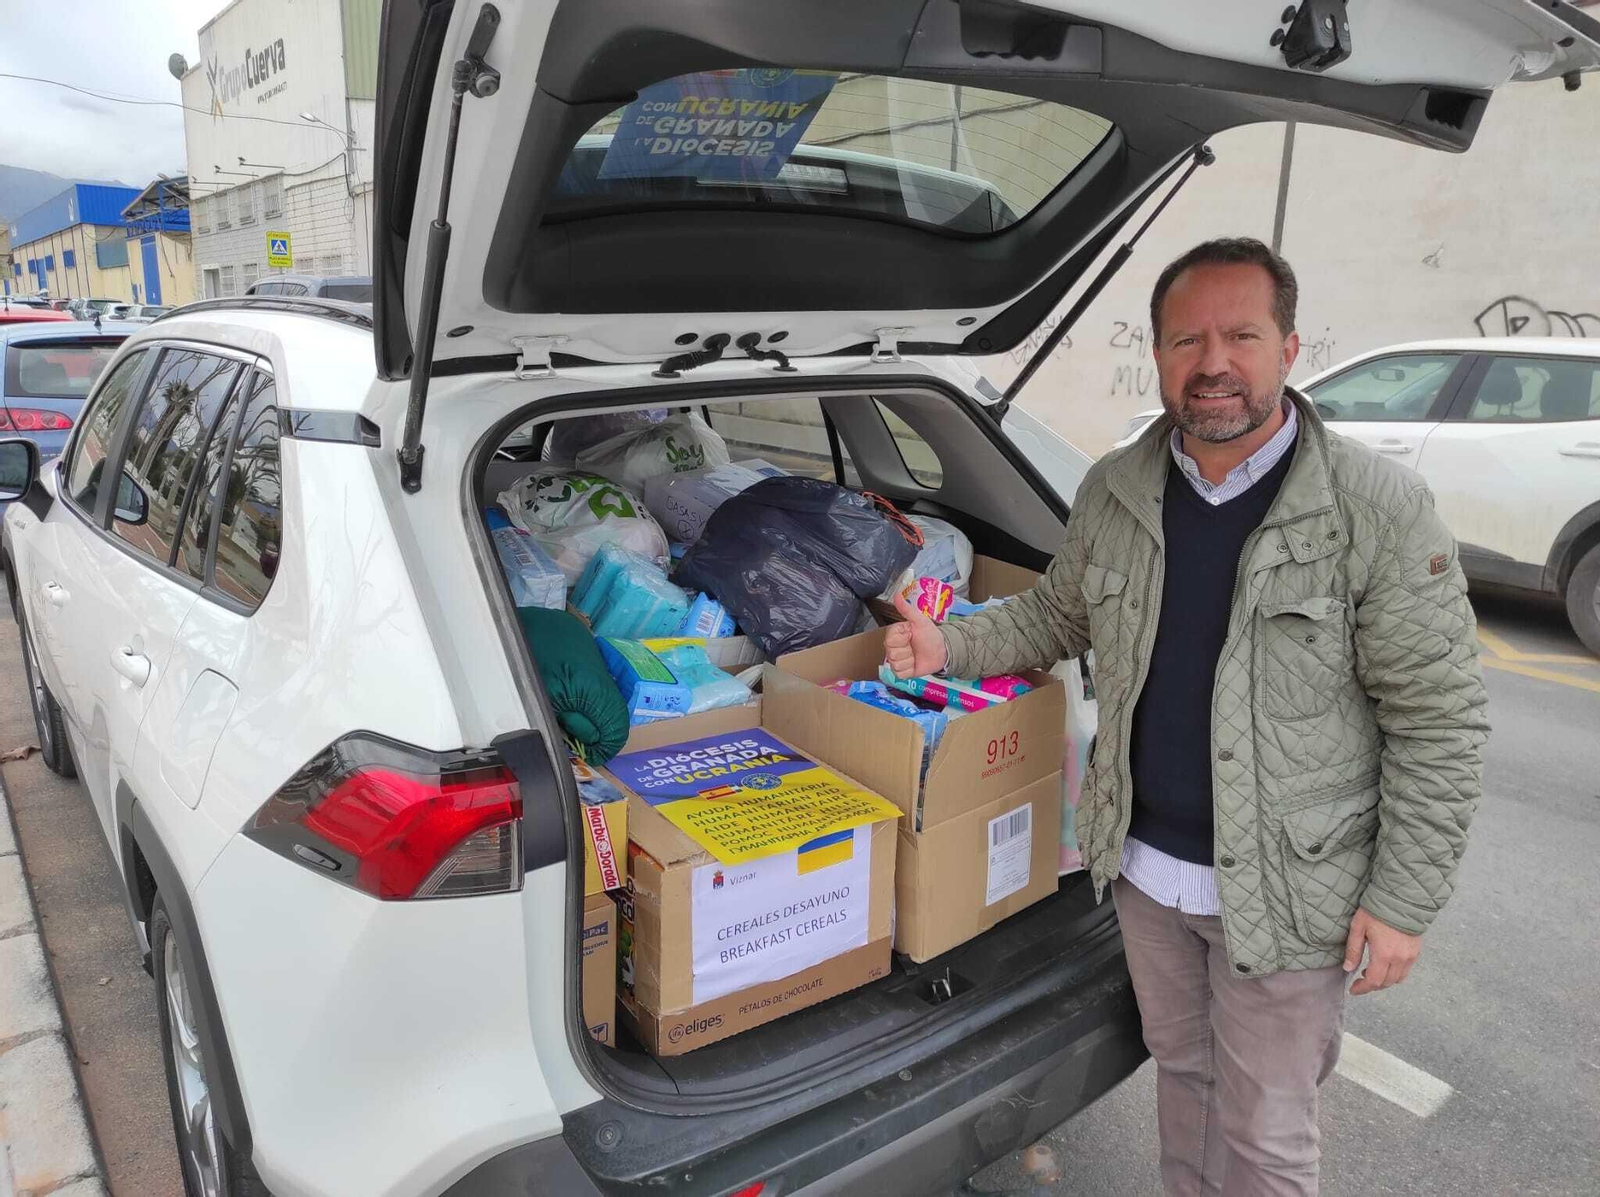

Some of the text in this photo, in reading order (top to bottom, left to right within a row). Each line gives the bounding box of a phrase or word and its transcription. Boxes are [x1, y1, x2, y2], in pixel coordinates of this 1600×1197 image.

[907, 678, 919, 691] 10
[637, 746, 779, 784] DE GRANADA
[987, 730, 1019, 765] 913
[634, 765, 650, 773] LA
[644, 754, 791, 789] CON UCRANIA
[686, 781, 831, 821] AYUDA HUMANITARIA
[694, 787, 841, 828] HUMANITARIAN AID
[704, 793, 850, 835] AIDE HUMANITAIRE
[721, 831, 773, 848] POMOC
[599, 851, 617, 888] Dorada
[717, 886, 851, 941] CEREALES DESAYUNO
[719, 908, 848, 964] BREAKFAST CEREALS
[773, 994, 784, 1005] DE
[784, 977, 824, 1000] CHOCOLATE
[685, 1014, 723, 1034] eliges
